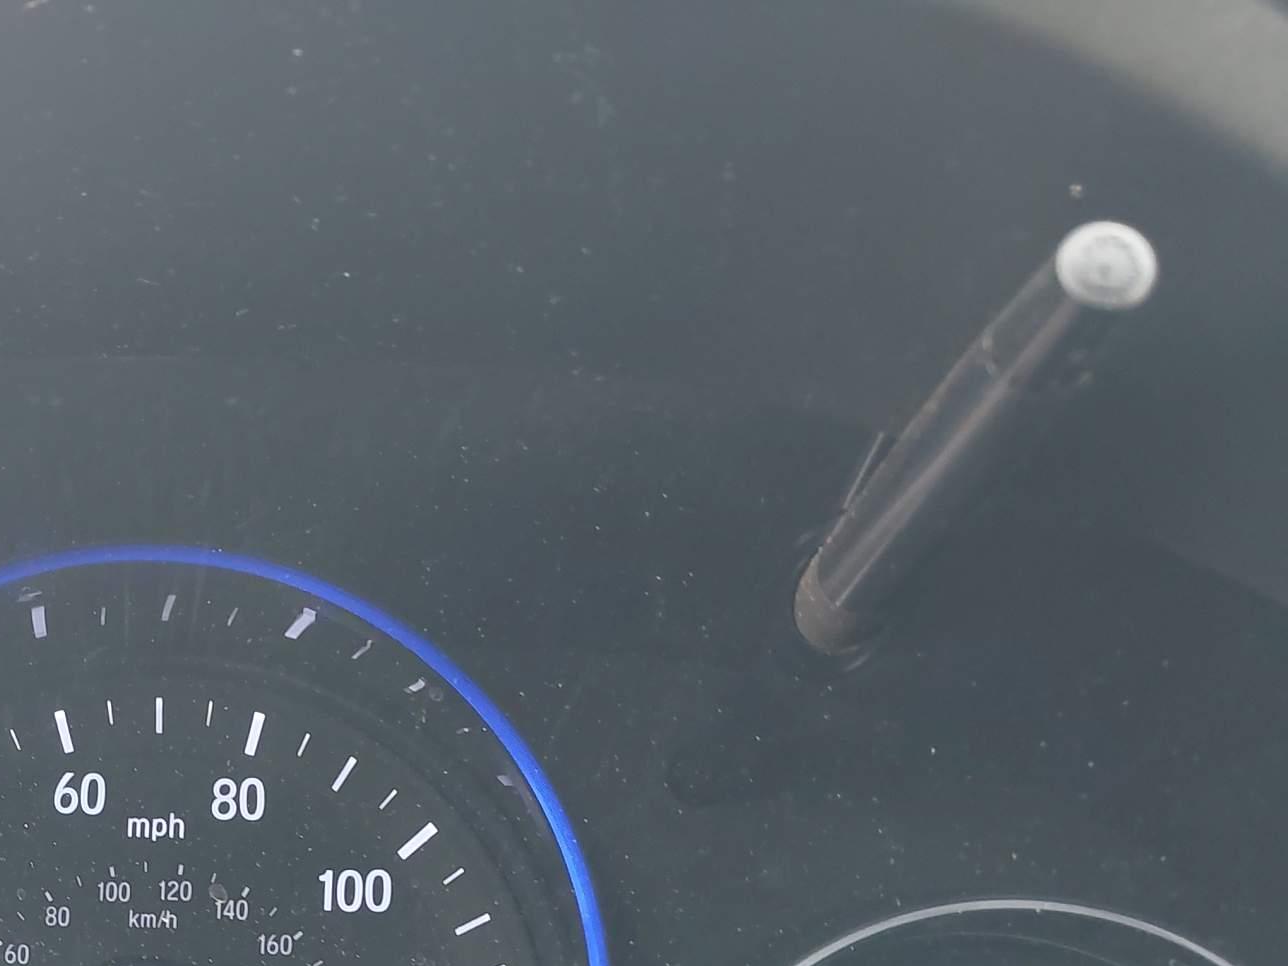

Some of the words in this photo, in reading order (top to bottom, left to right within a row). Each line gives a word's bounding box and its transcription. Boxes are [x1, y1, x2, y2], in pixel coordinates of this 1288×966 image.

[53, 772, 106, 816] 60
[211, 777, 265, 821] 80
[127, 812, 185, 842] mph
[97, 881, 131, 903] 100
[159, 880, 192, 902] 120
[318, 869, 392, 913] 100
[45, 906, 70, 927] 80
[128, 909, 177, 929] km/h
[215, 900, 249, 922] 140
[4, 943, 30, 965] 60
[258, 934, 292, 956] 160
